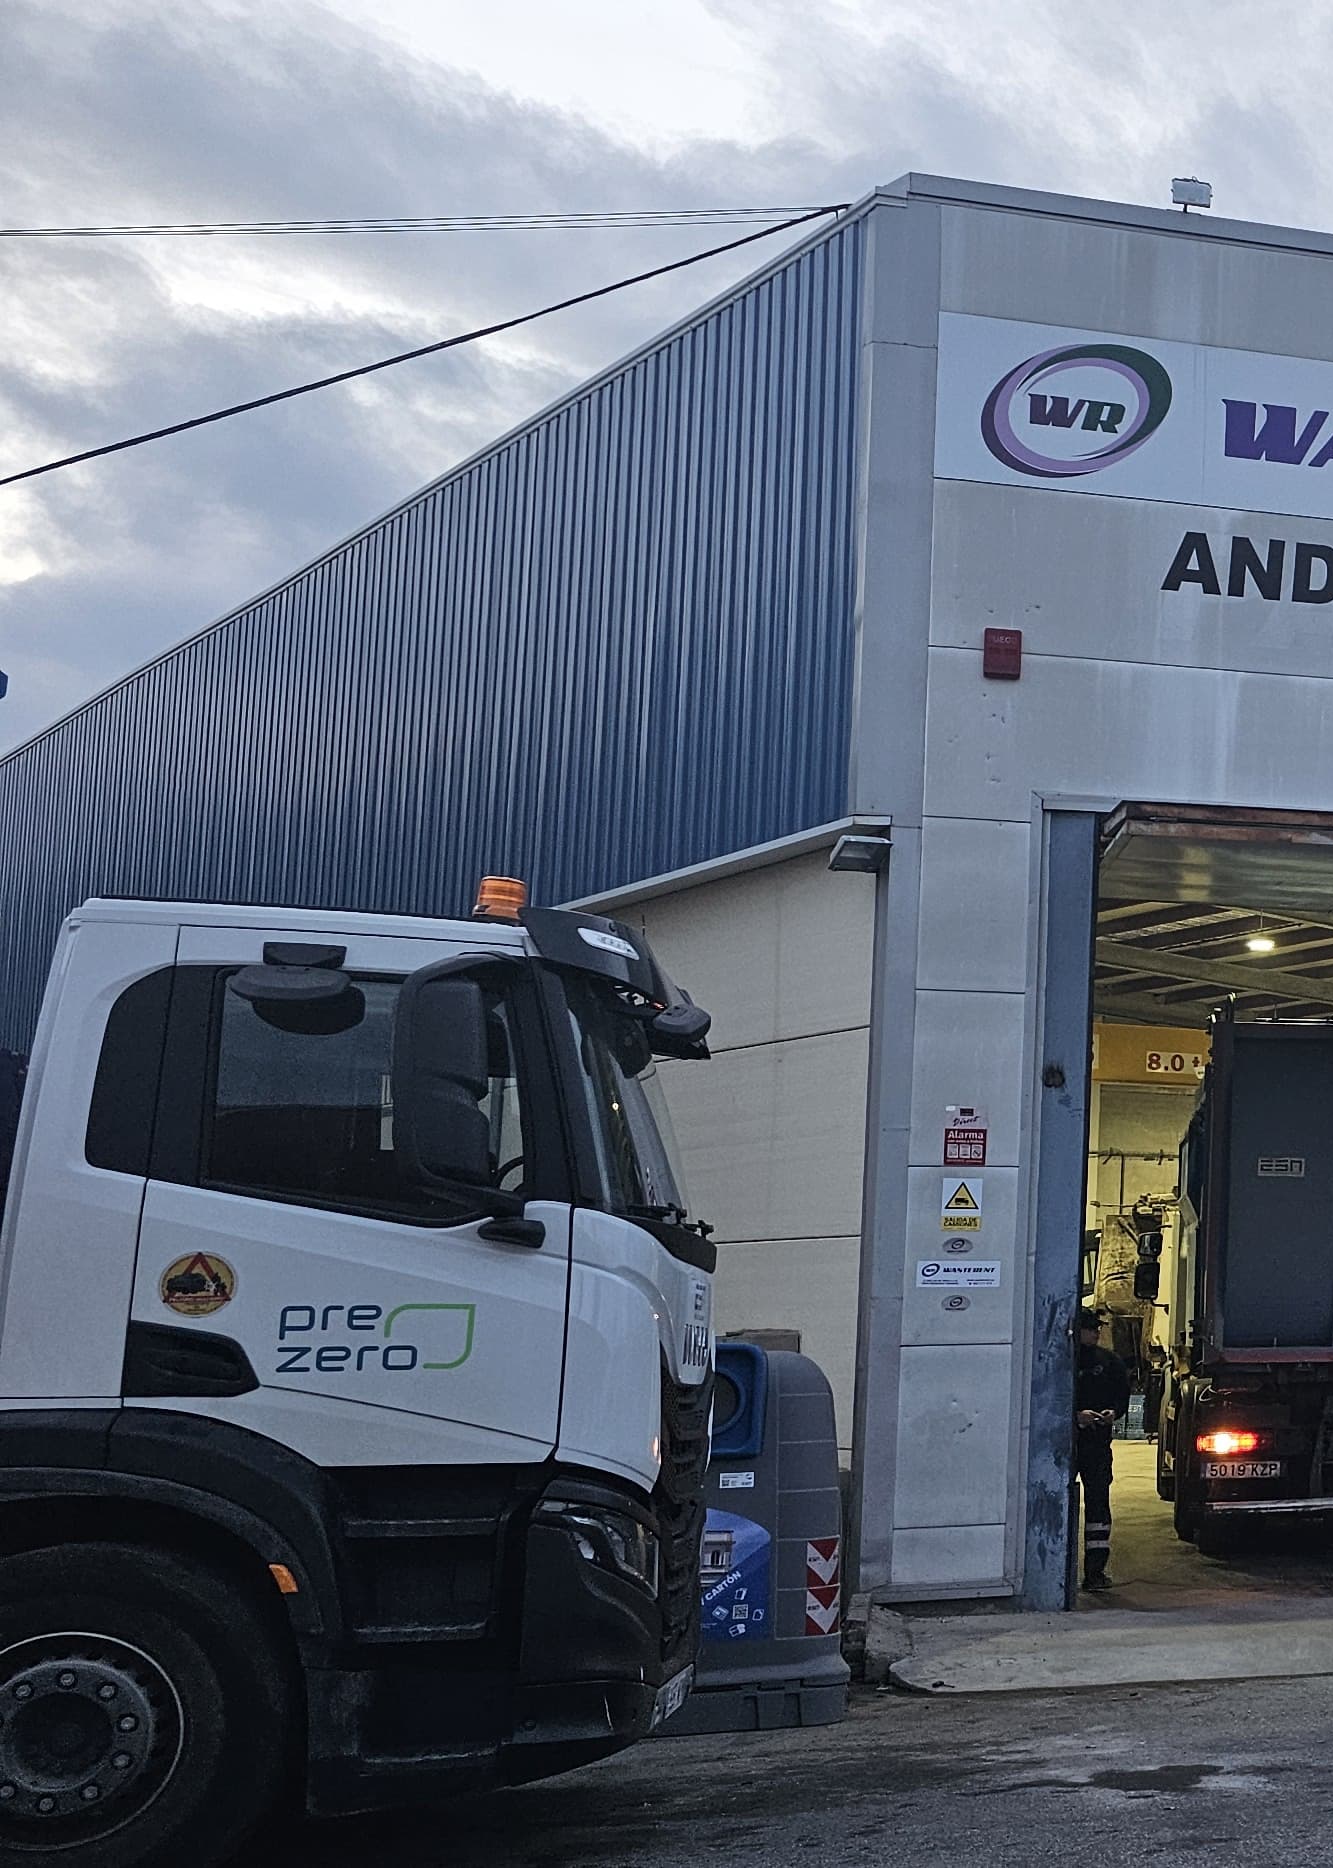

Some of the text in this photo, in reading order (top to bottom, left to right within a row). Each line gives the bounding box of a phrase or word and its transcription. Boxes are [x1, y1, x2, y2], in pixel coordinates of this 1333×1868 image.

[1026, 392, 1127, 435] WR
[1147, 1053, 1184, 1072] 8.0
[947, 1130, 984, 1140] Alarma
[278, 1304, 383, 1341] pre
[276, 1343, 418, 1374] zero
[1210, 1464, 1246, 1477] 5019
[705, 1571, 742, 1601] CARTÓN
